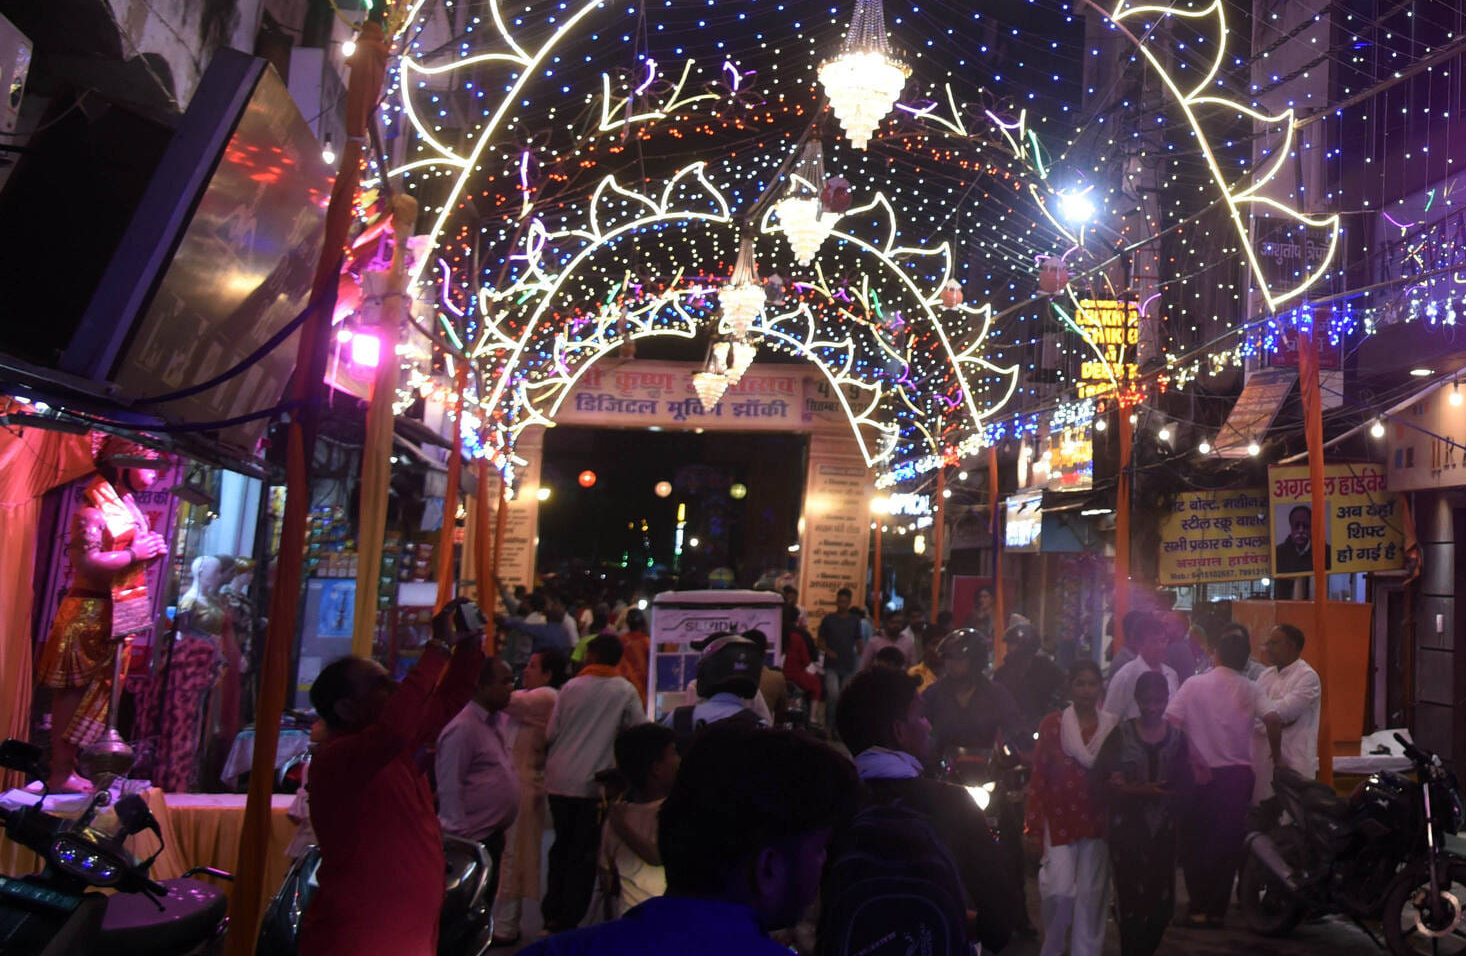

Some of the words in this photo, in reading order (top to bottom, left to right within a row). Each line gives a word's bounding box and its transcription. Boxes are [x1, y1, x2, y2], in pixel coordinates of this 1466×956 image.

[575, 393, 658, 415] डिजिटल
[1336, 505, 1363, 520] अब
[1346, 521, 1387, 539] शिफ्ट
[1163, 536, 1187, 553] सभी
[1189, 539, 1220, 553] प्रकार
[1336, 544, 1354, 563] हो
[1356, 542, 1381, 562] गई
